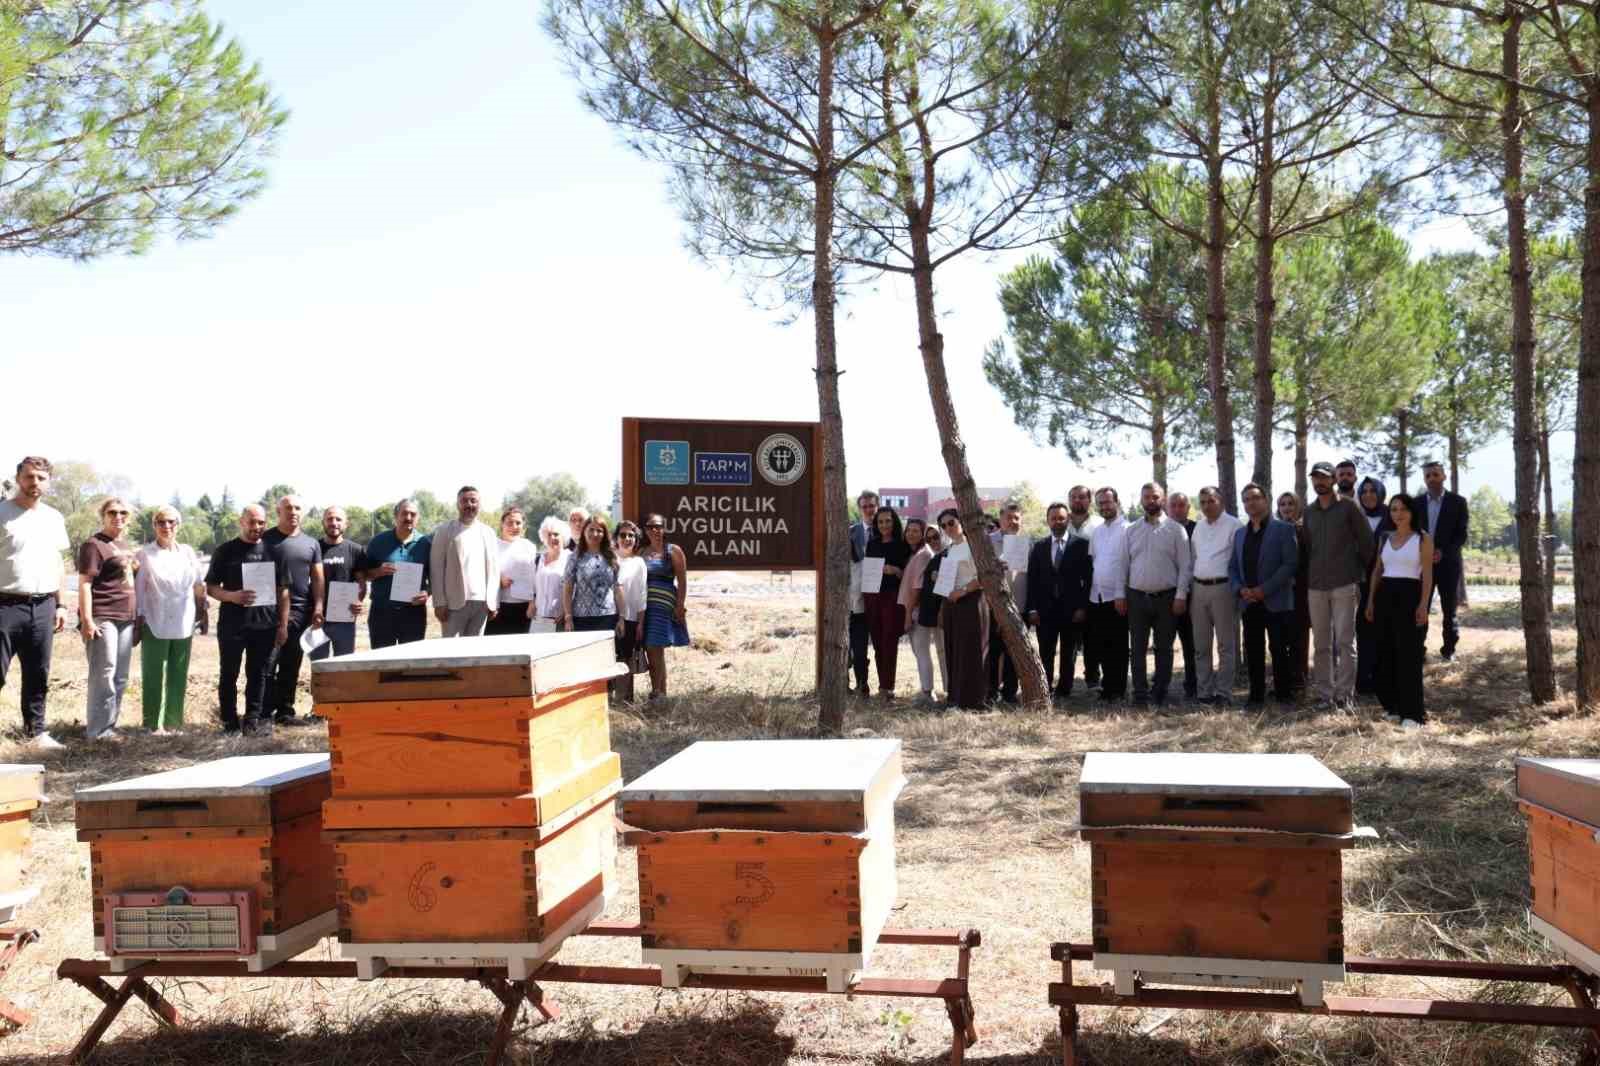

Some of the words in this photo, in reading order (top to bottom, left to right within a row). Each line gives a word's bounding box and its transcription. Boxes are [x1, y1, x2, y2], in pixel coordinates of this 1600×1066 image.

[677, 496, 776, 512] ARICILIK
[663, 518, 789, 534] UYGULAMA
[693, 539, 761, 556] ALANI
[408, 861, 438, 912] 6
[735, 861, 775, 907] 5
